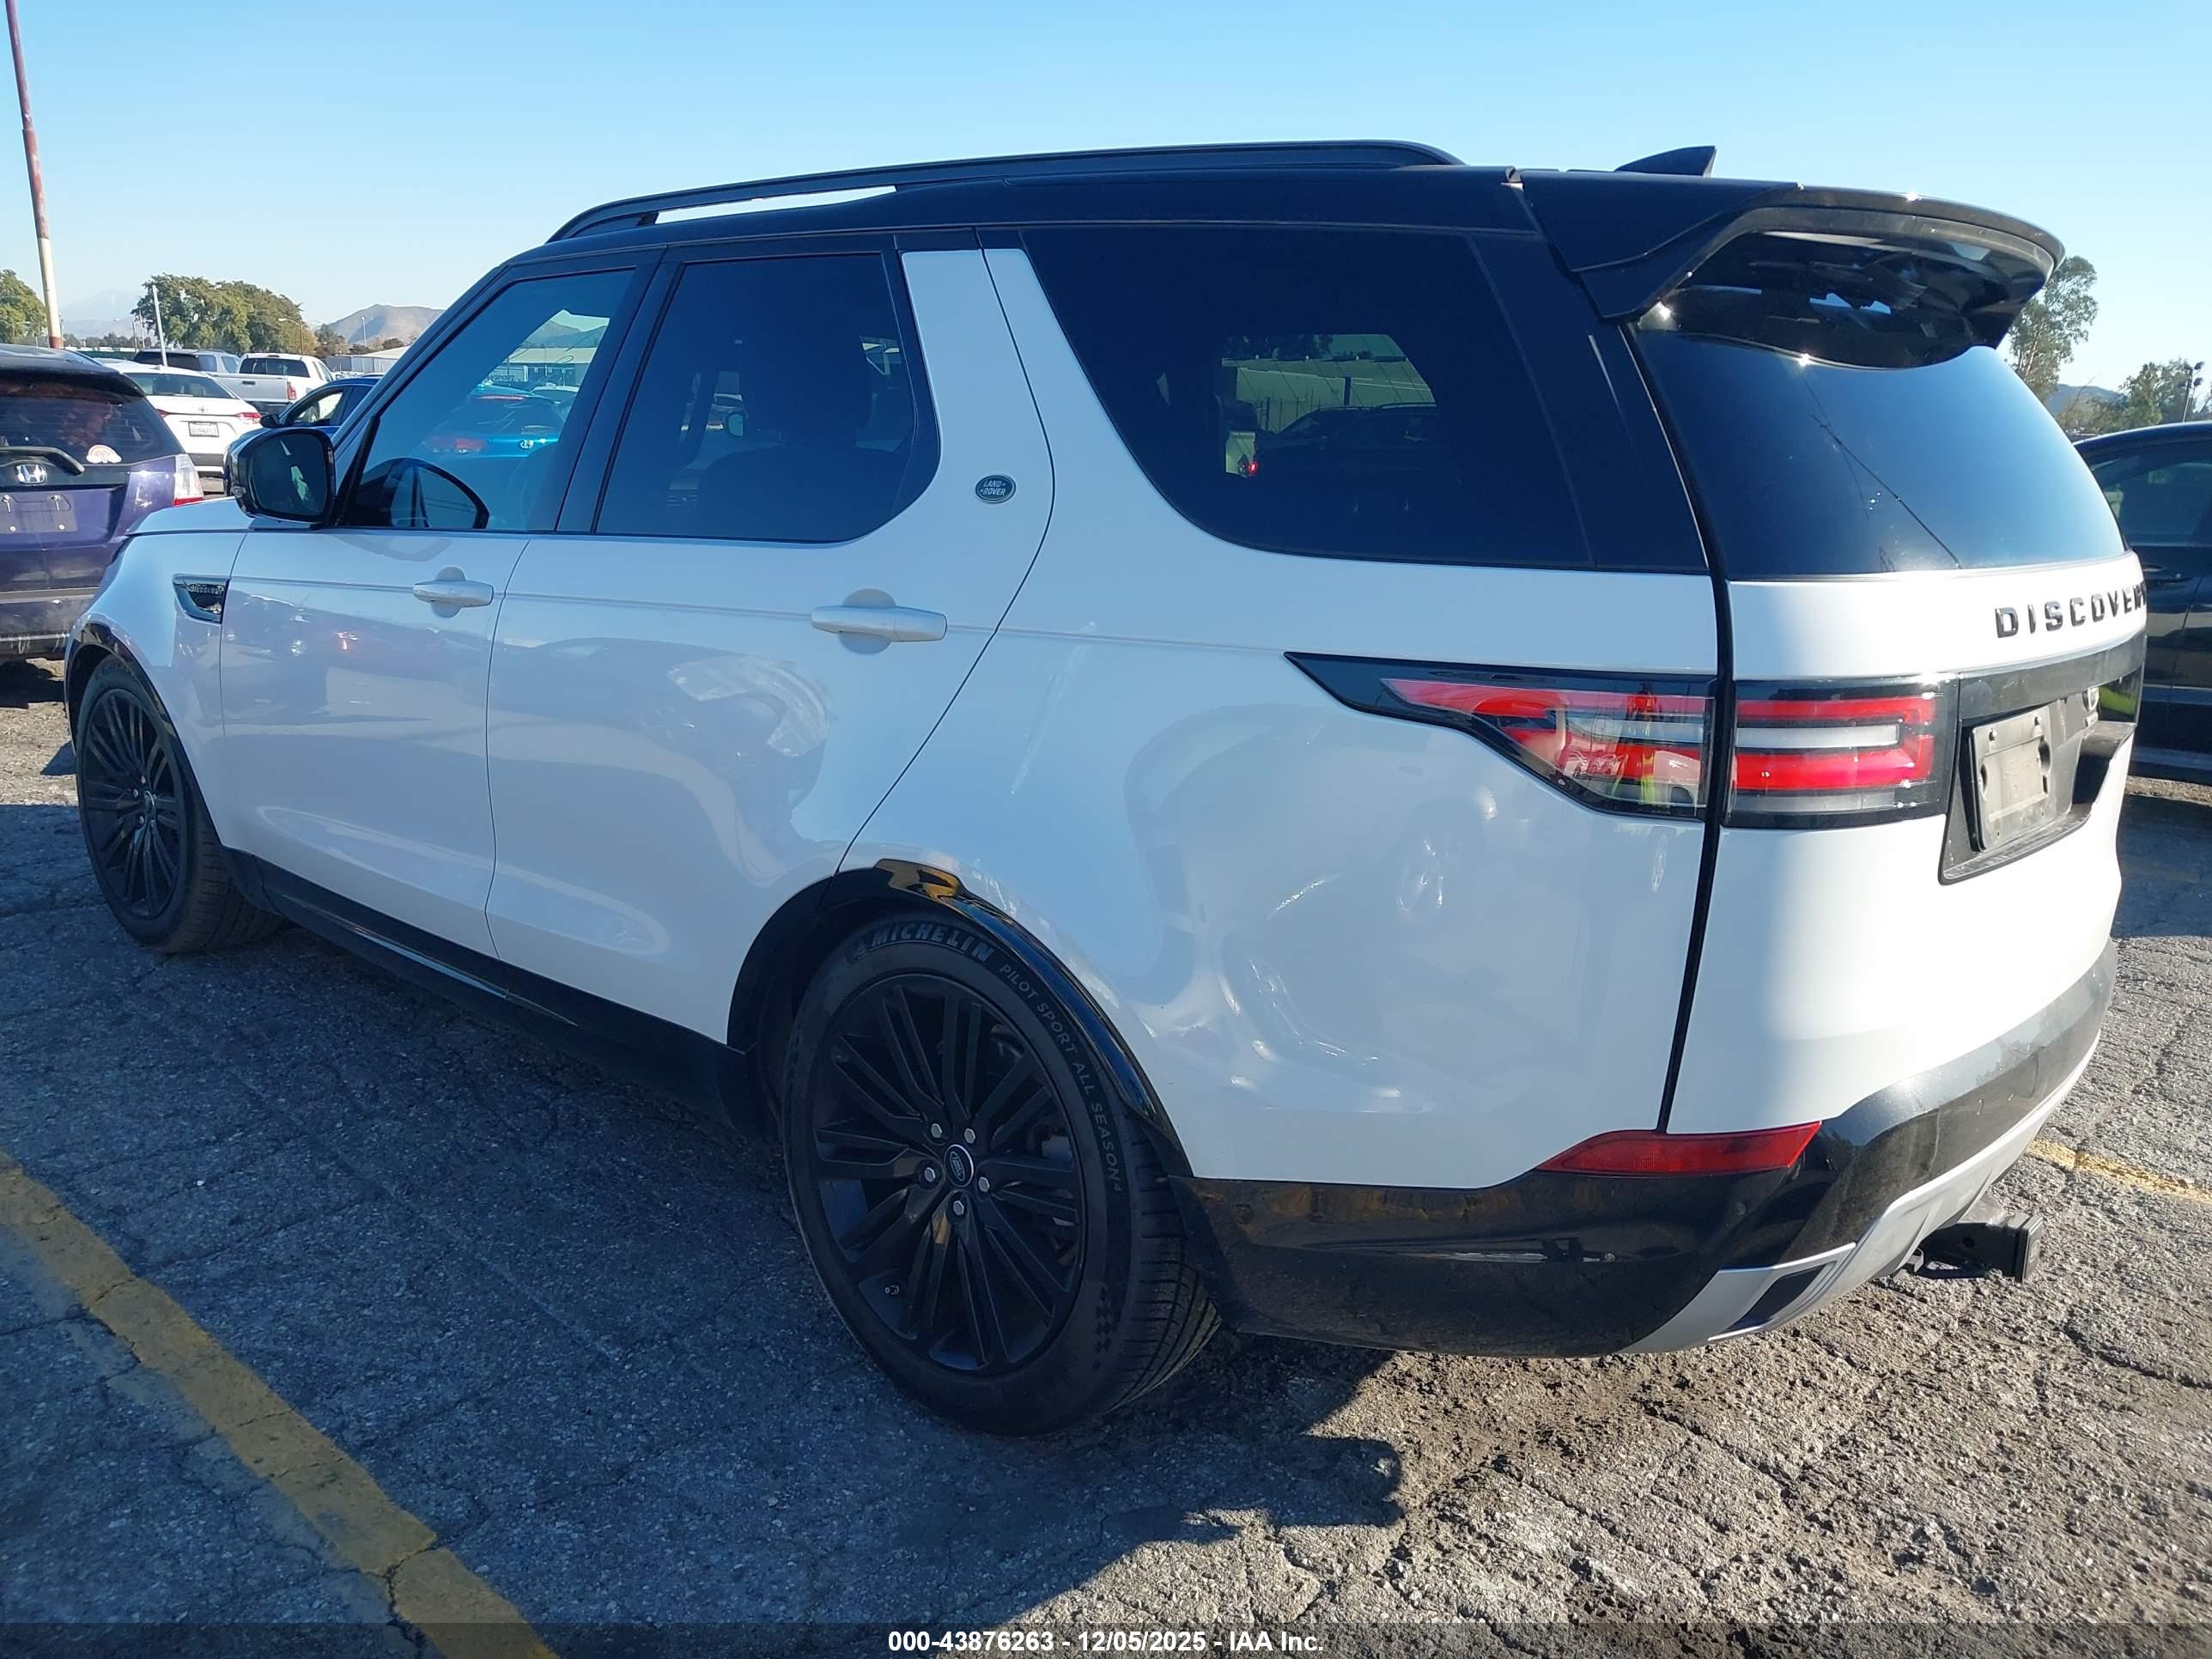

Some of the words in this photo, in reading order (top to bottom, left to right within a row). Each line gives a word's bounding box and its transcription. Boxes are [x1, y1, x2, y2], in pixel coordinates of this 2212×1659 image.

[872, 922, 995, 963] MICHELIN
[999, 963, 1038, 1001] PILOT
[1036, 1001, 1078, 1057] SPORT
[1072, 1062, 1096, 1096] ALL
[1091, 1103, 1121, 1182] SEASON
